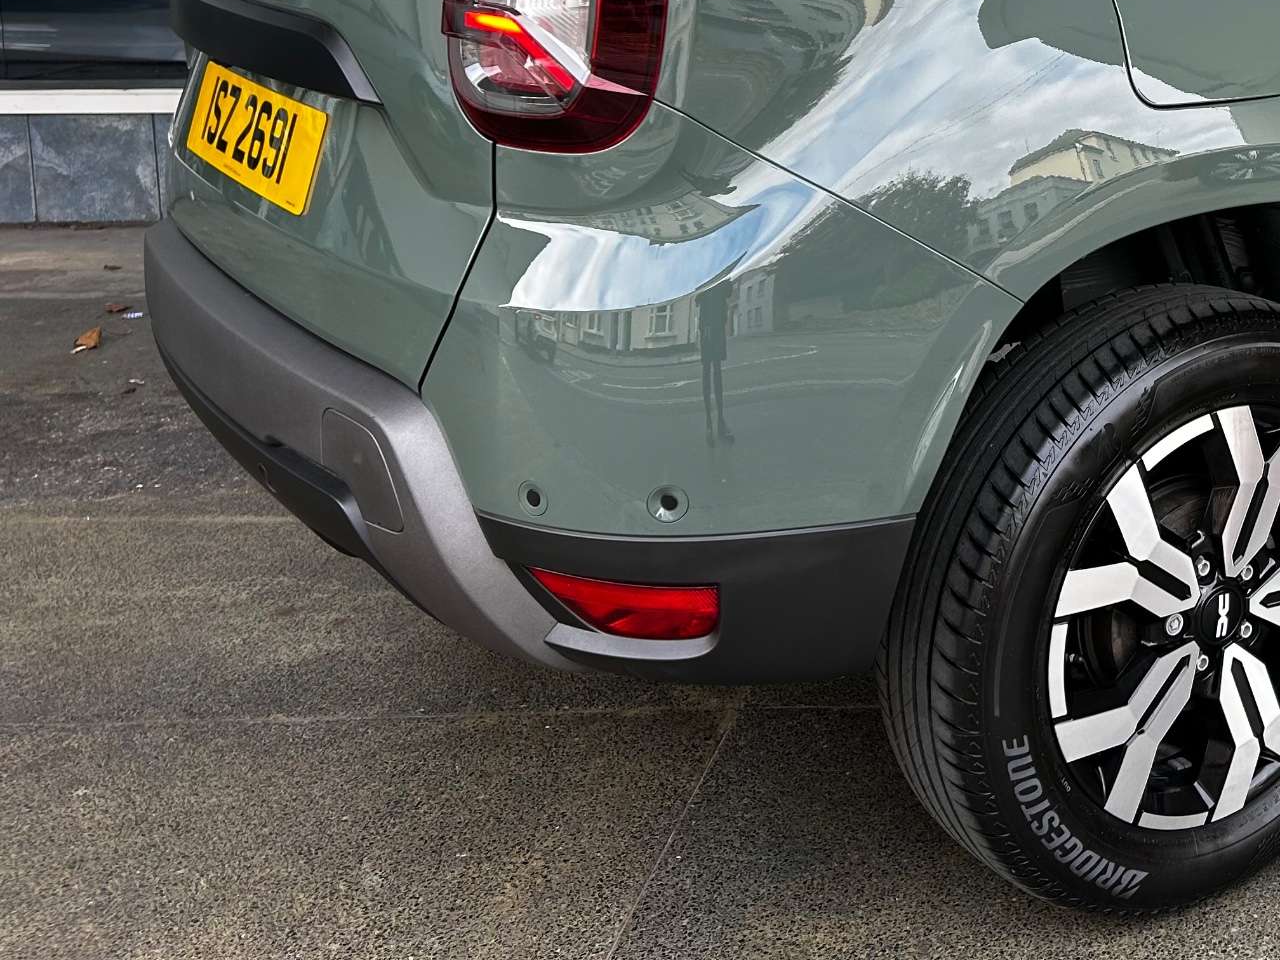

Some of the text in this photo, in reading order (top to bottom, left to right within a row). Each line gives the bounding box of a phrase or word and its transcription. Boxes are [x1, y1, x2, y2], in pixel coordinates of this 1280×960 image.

[201, 75, 299, 186] ISZ 2691
[1002, 734, 1150, 899] BRIDGESTONE
